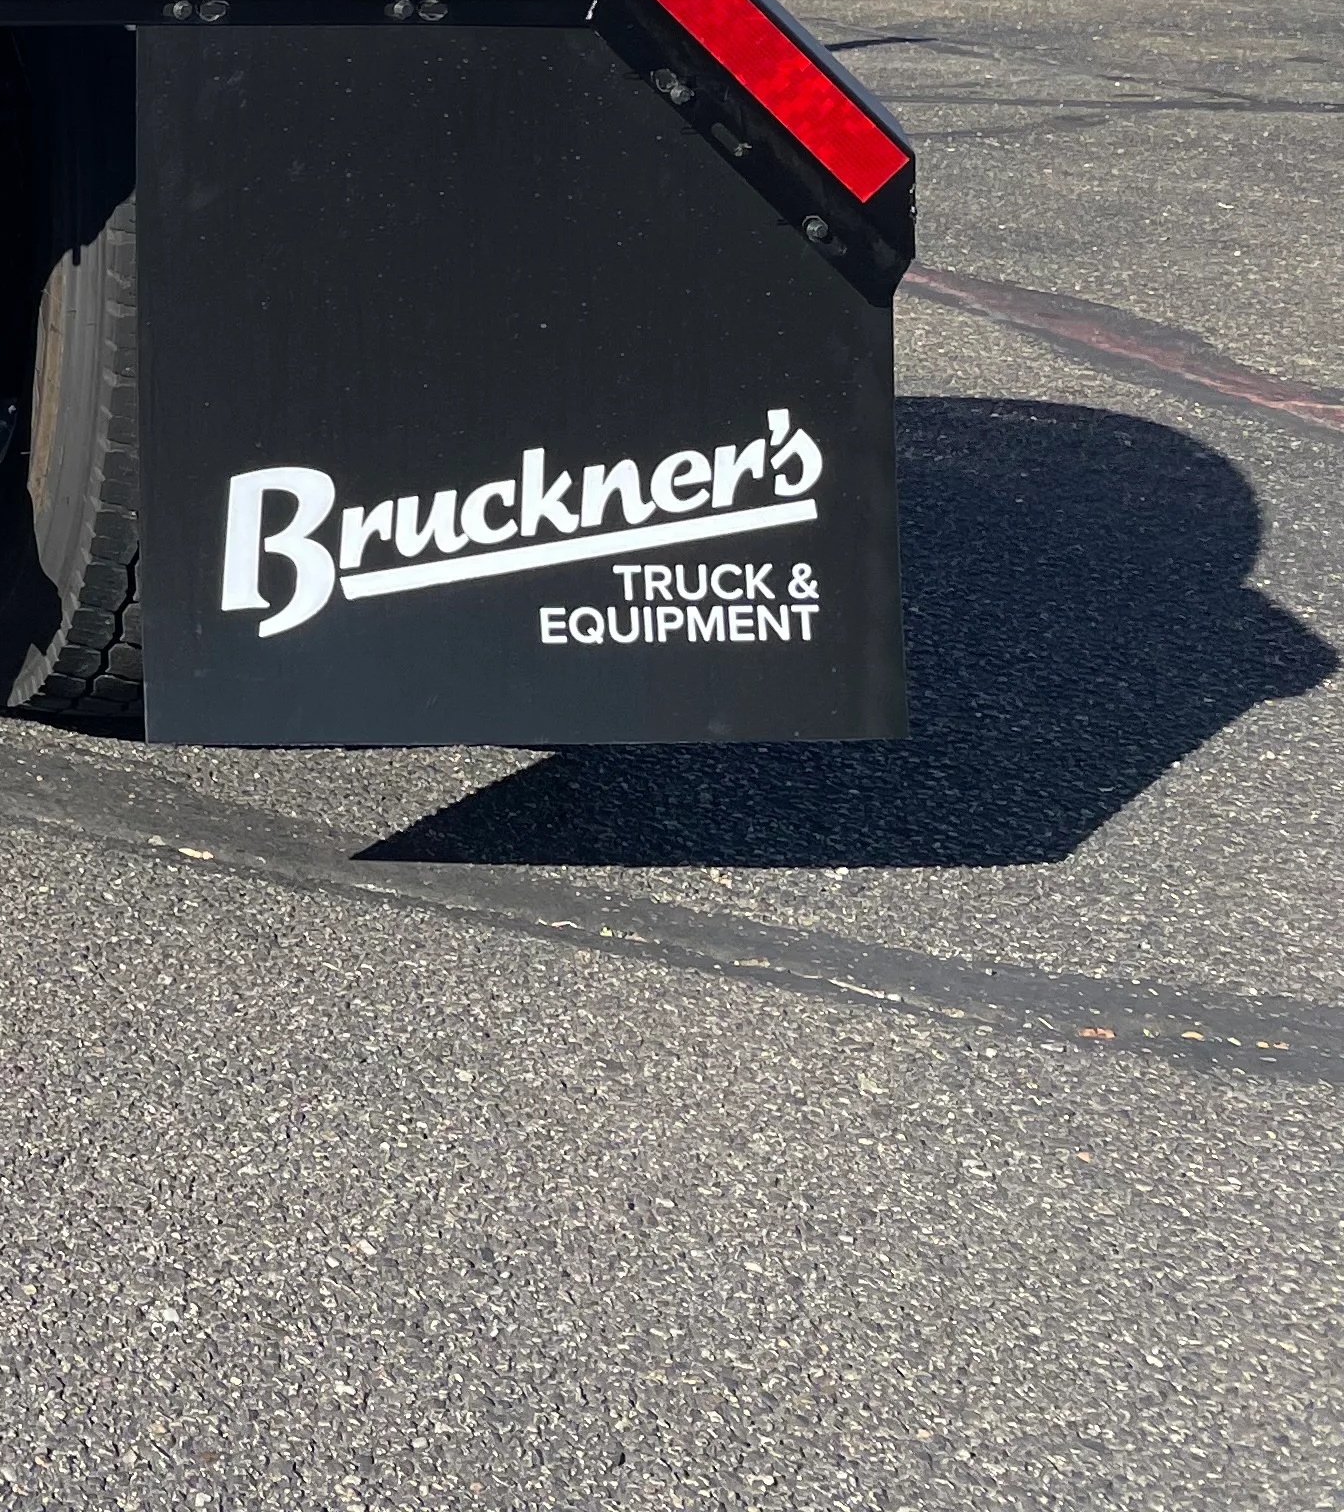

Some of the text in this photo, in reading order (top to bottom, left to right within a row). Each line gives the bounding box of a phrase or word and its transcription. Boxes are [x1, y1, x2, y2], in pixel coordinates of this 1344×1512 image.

[221, 409, 823, 638] Bruckner's
[612, 563, 820, 601] TRUCK &
[539, 605, 820, 645] EQUIPMENT
